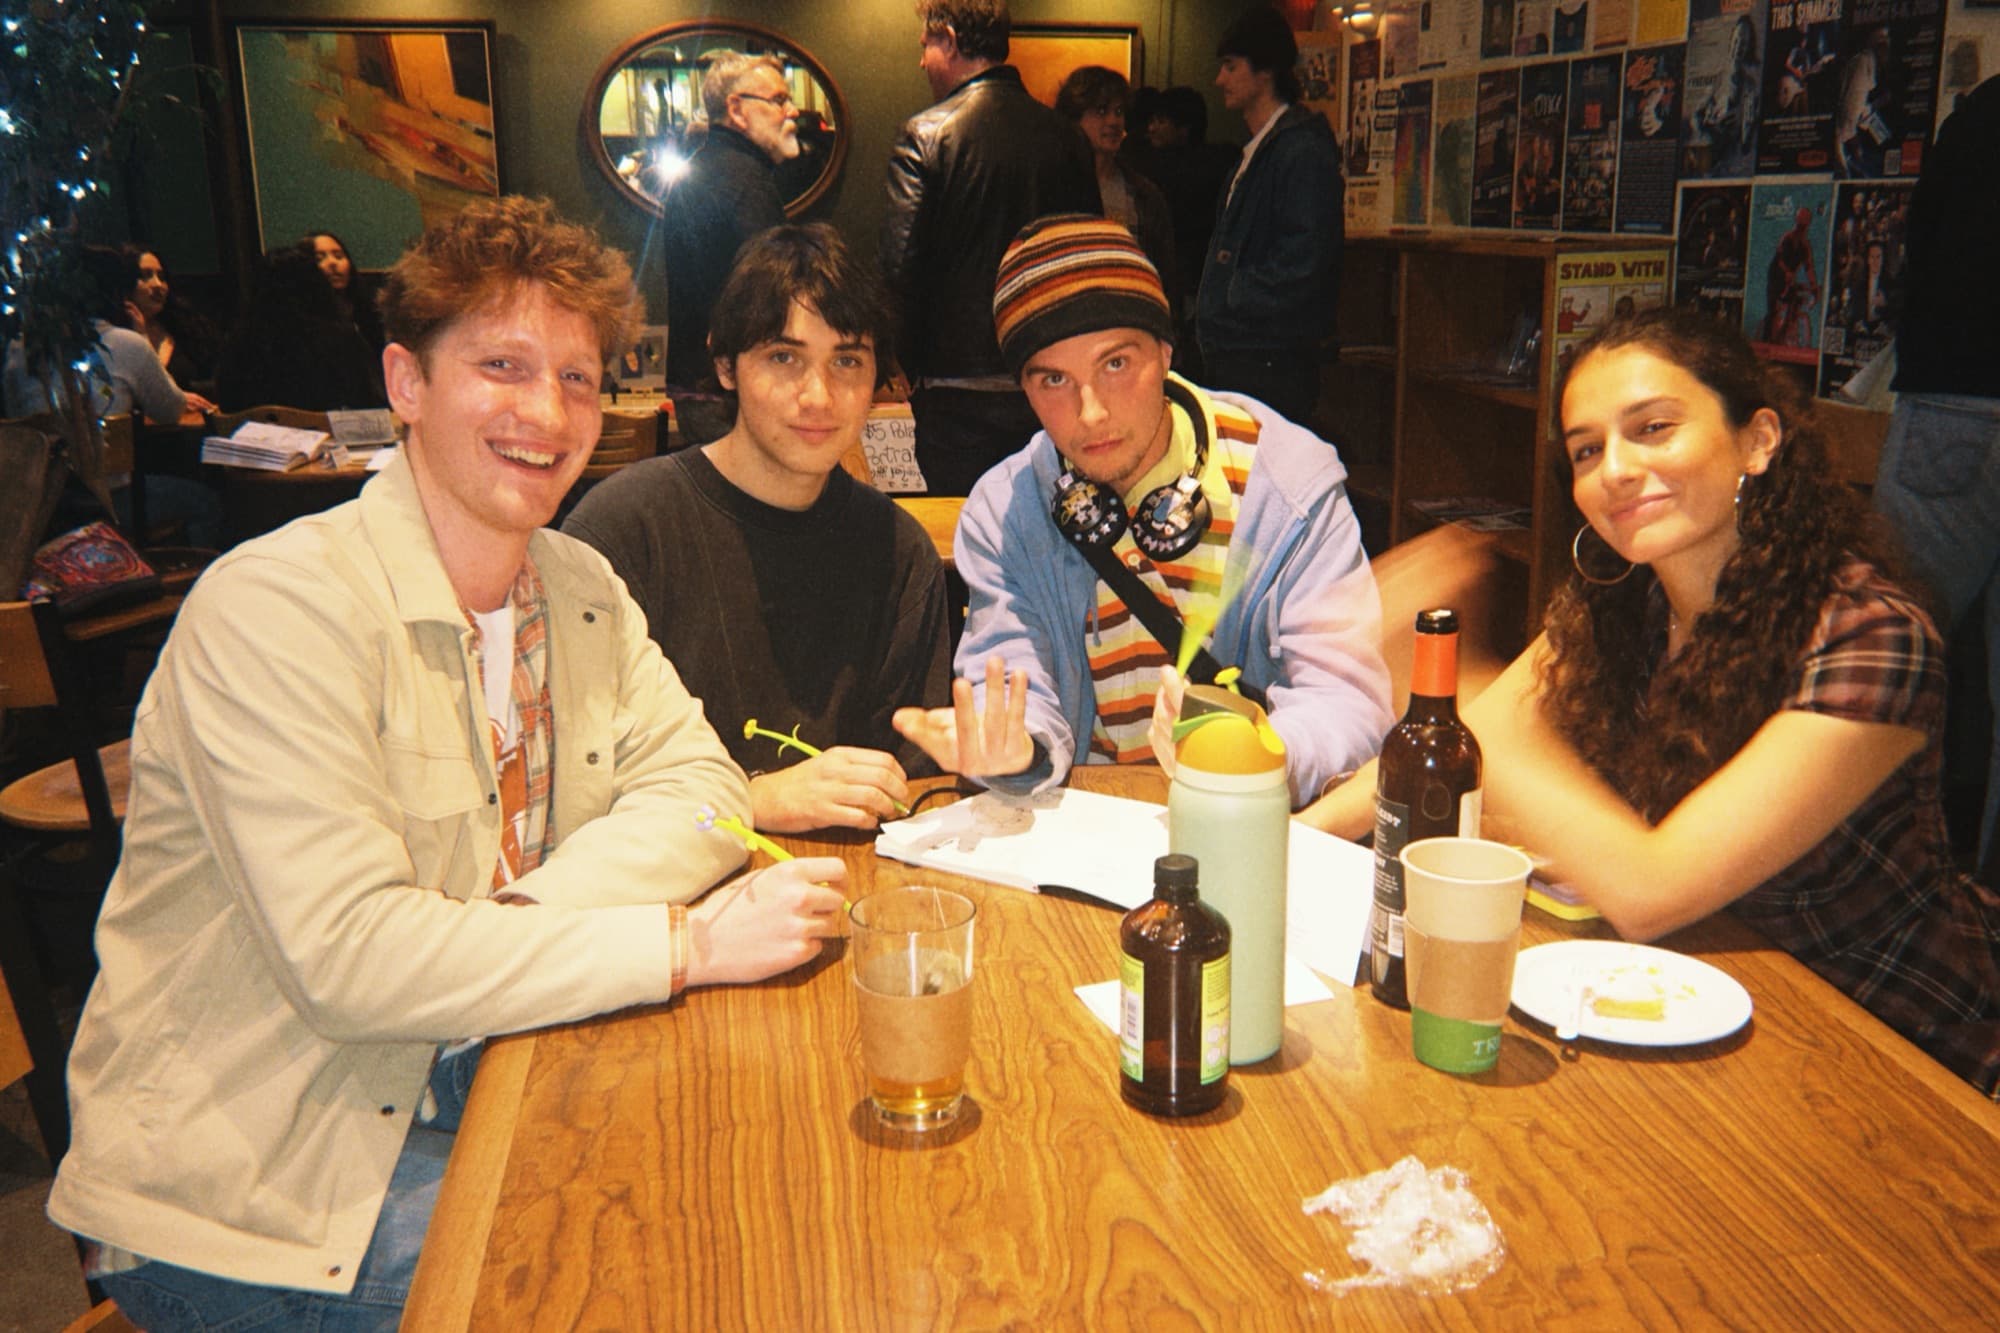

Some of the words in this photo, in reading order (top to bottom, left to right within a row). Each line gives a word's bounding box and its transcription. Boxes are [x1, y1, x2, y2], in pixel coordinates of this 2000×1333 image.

[1771, 4, 1793, 30] THIS
[1560, 261, 1616, 280] STAND
[1621, 259, 1665, 279] WITH
